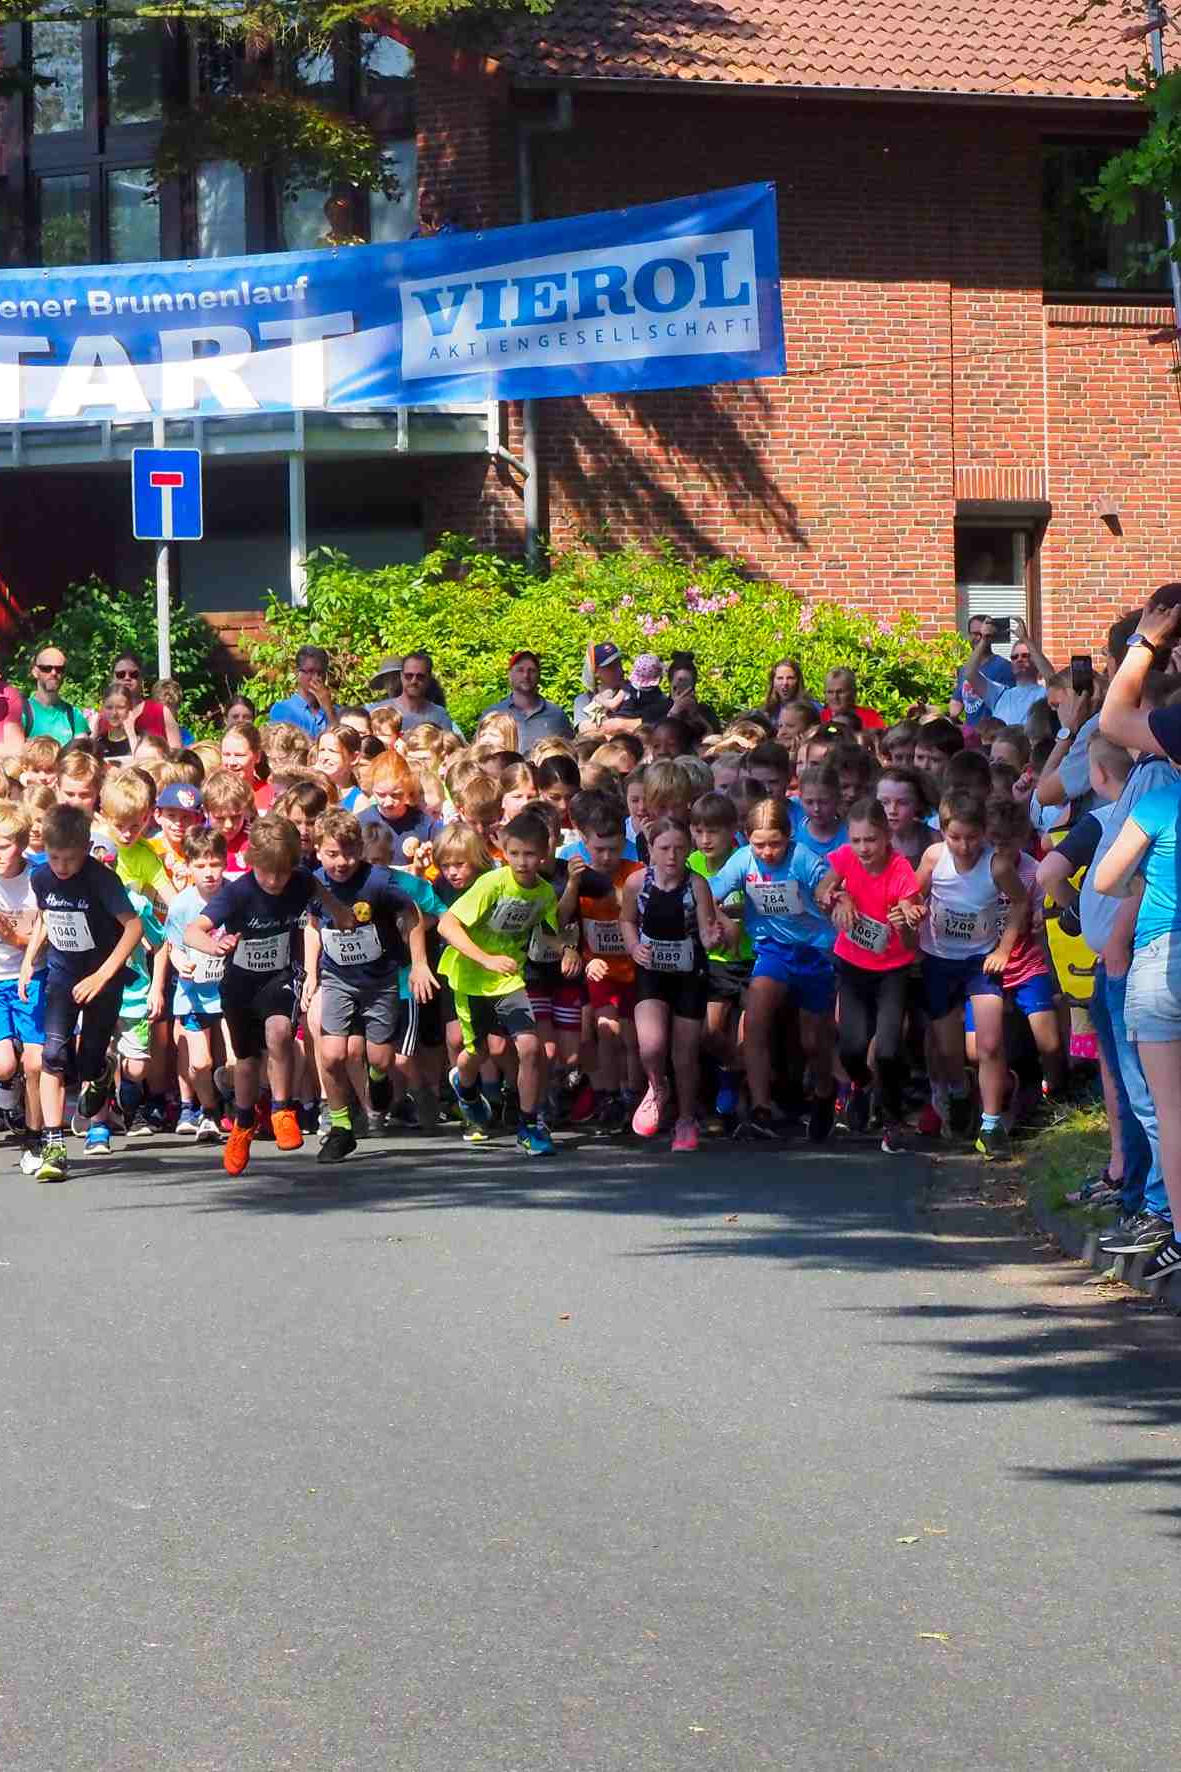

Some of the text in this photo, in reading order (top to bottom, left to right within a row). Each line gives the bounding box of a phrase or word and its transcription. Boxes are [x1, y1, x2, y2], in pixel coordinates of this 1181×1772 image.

[87, 275, 308, 316] Brunnenlauf
[411, 251, 750, 337] VIEROL
[429, 317, 752, 361] AKTIENGESELLSCHAFT
[762, 894, 785, 903] 784
[52, 926, 77, 937] 1040
[339, 942, 362, 952] 291
[246, 949, 278, 961] 1048
